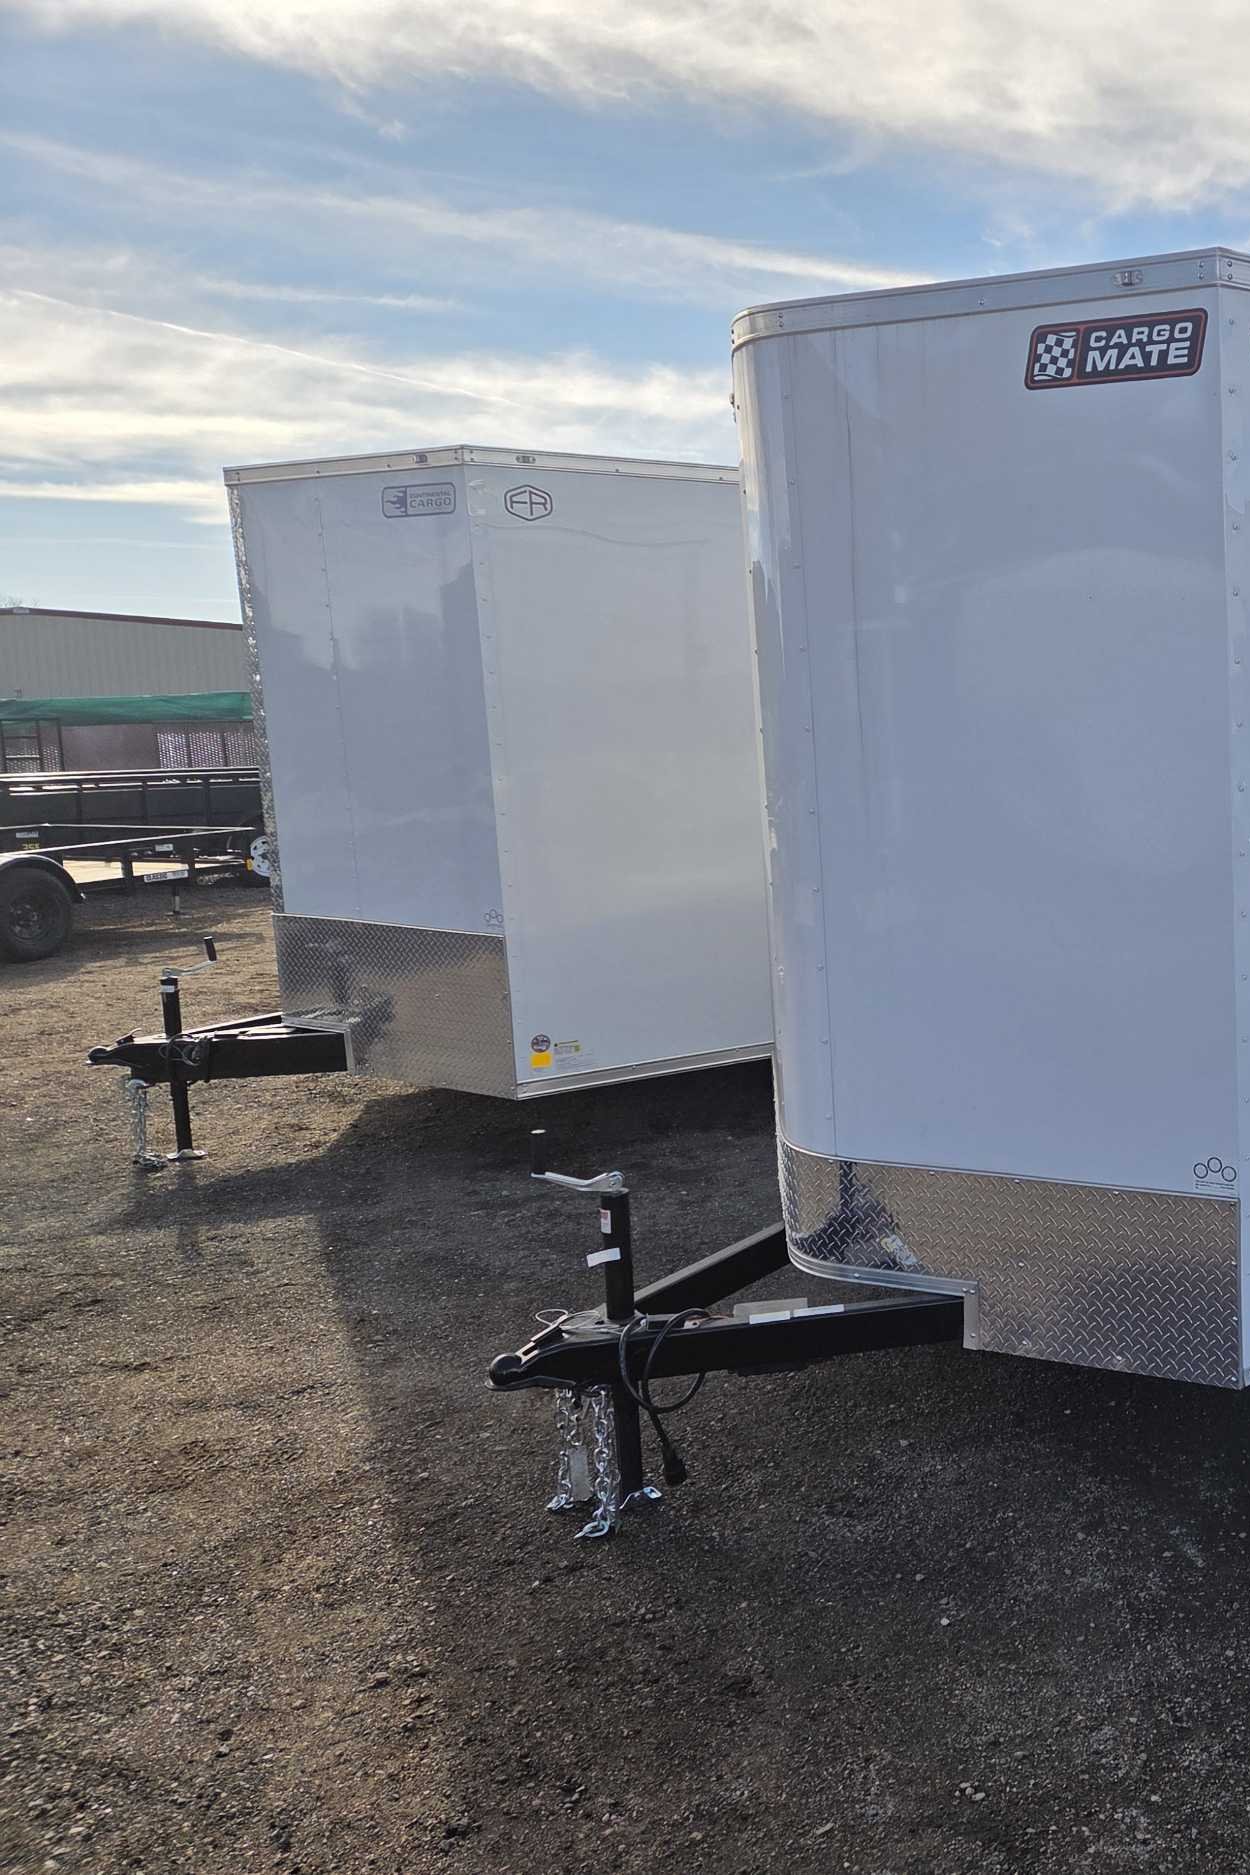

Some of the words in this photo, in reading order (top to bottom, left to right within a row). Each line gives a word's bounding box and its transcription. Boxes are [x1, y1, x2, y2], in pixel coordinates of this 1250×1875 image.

[1089, 321, 1193, 348] CARGO
[1085, 341, 1191, 373] MATE
[409, 497, 452, 508] CARGO
